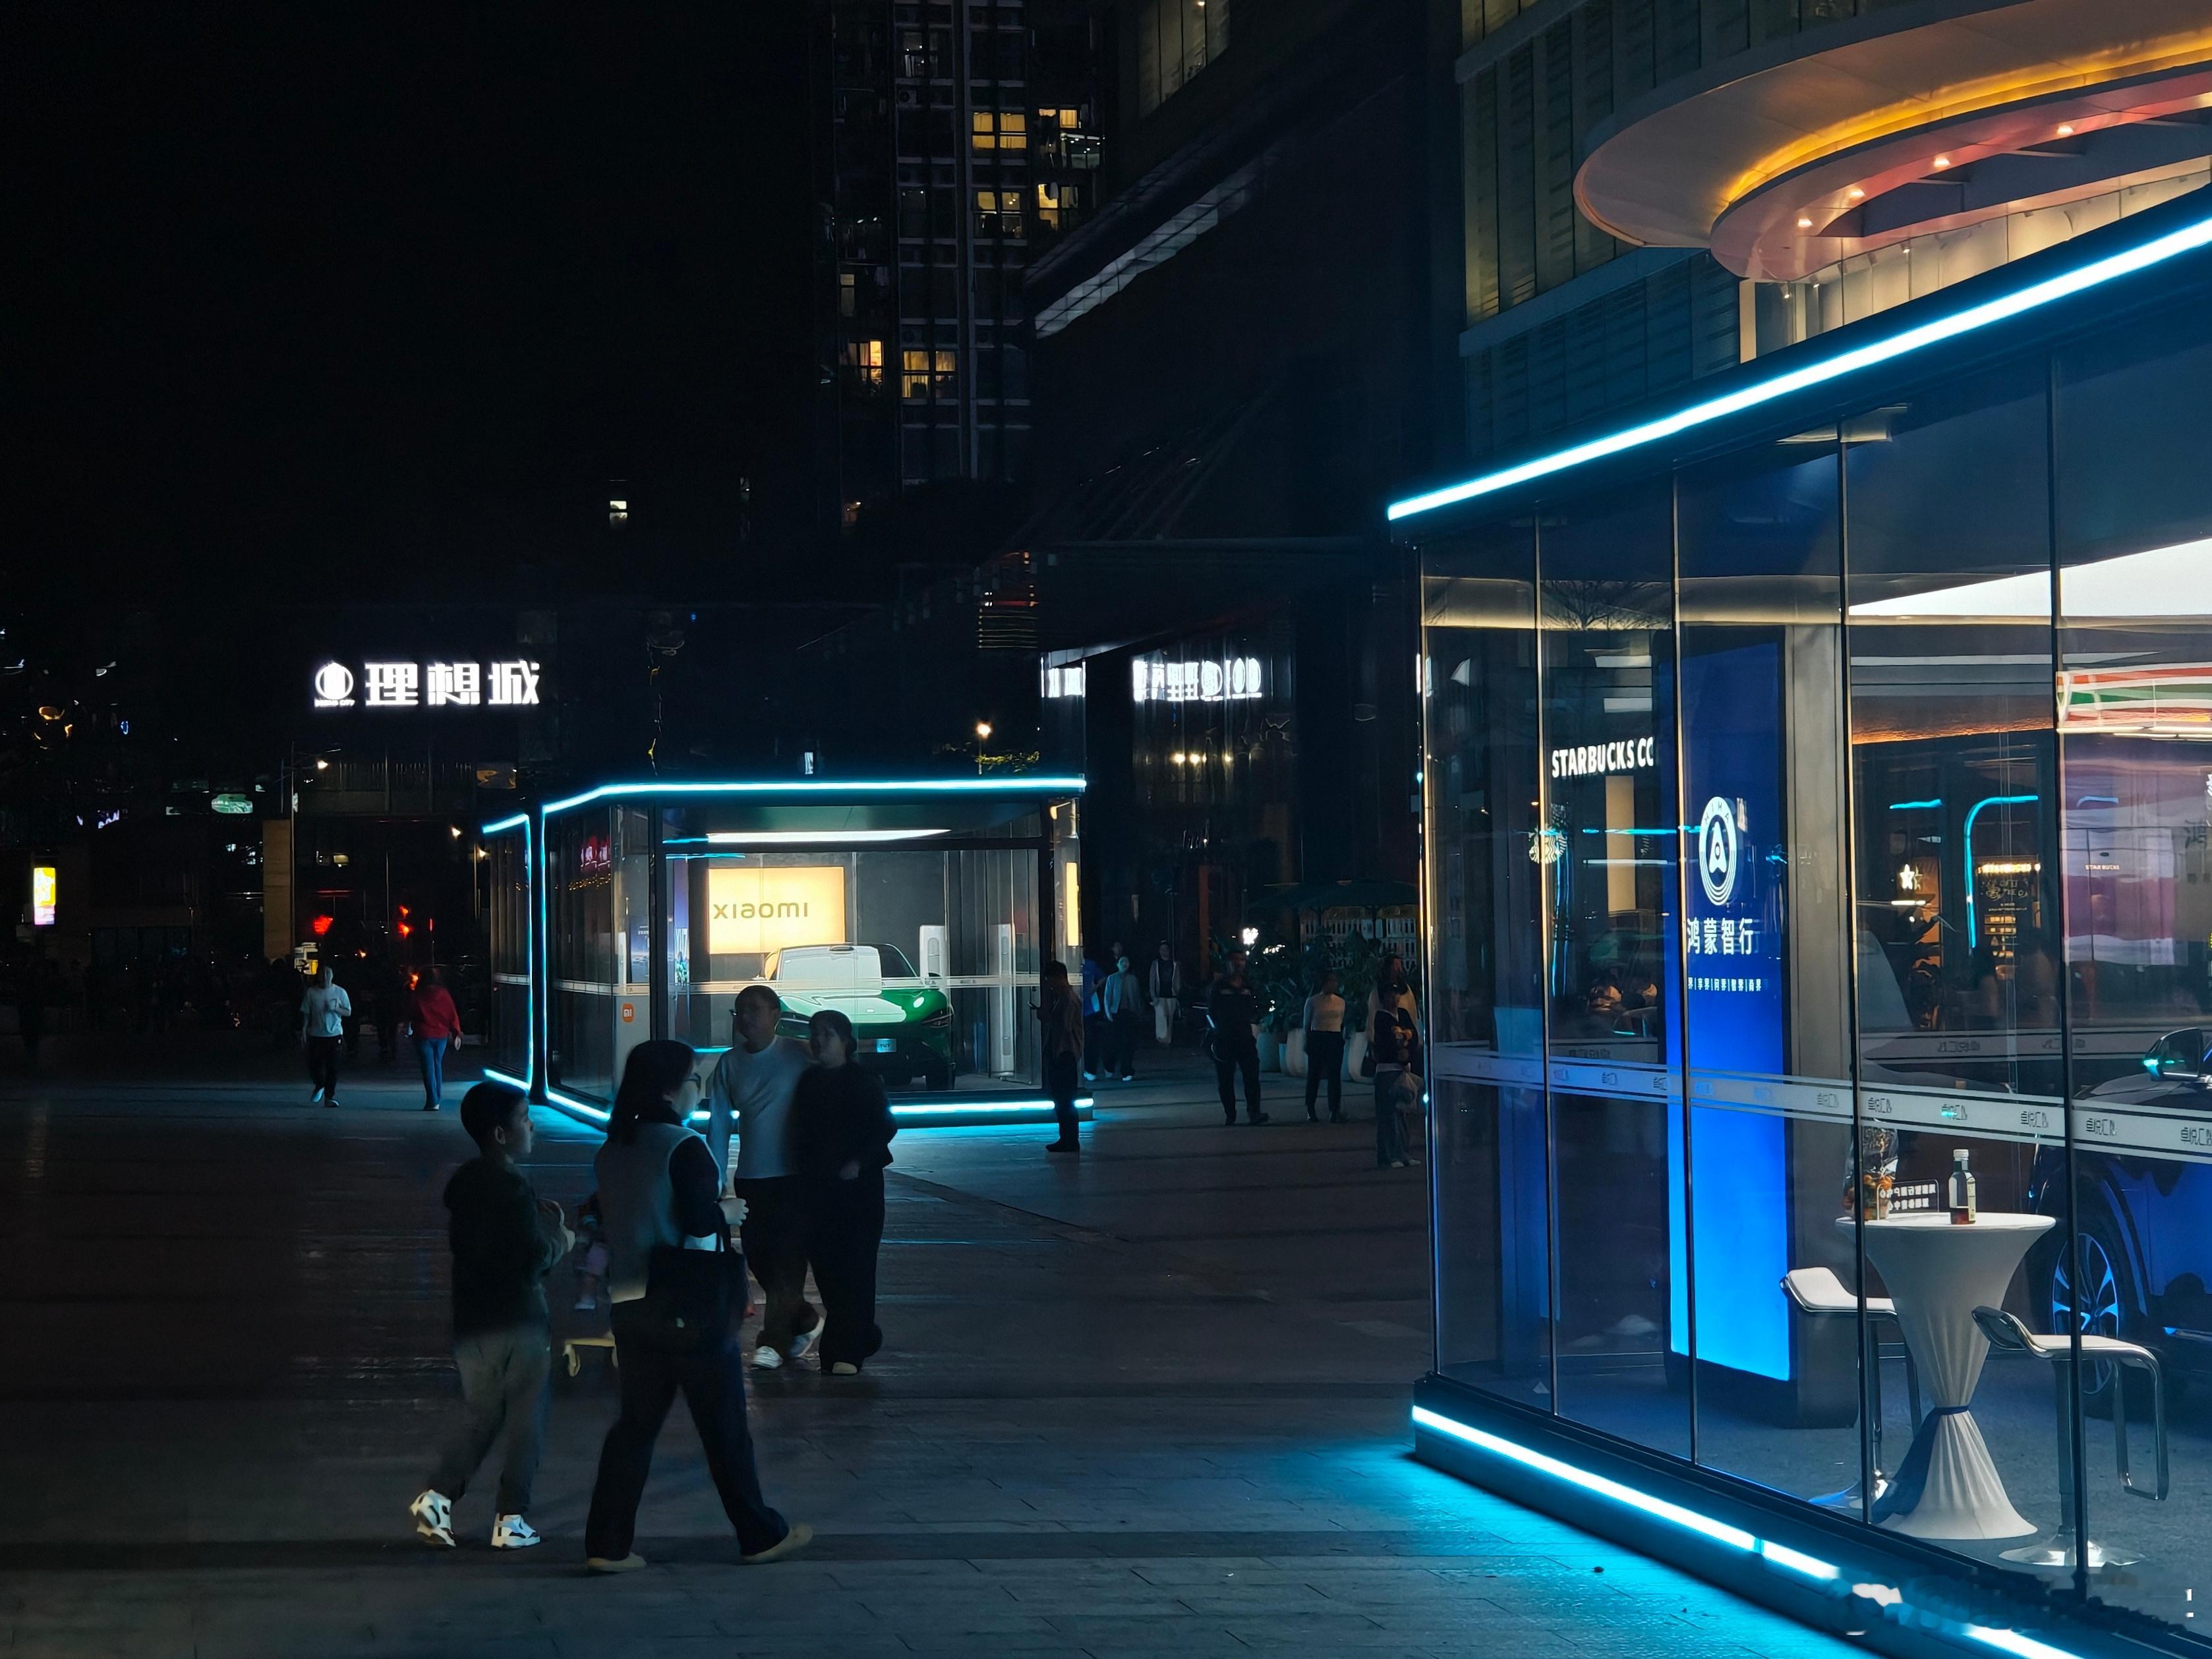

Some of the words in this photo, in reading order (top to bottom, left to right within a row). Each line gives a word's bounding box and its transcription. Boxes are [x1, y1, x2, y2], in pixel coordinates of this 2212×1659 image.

[364, 659, 540, 706] 理想城
[1552, 740, 1635, 778] STARBUCKS
[713, 902, 808, 919] xiaomi
[1687, 917, 1754, 955] 鸿蒙智行
